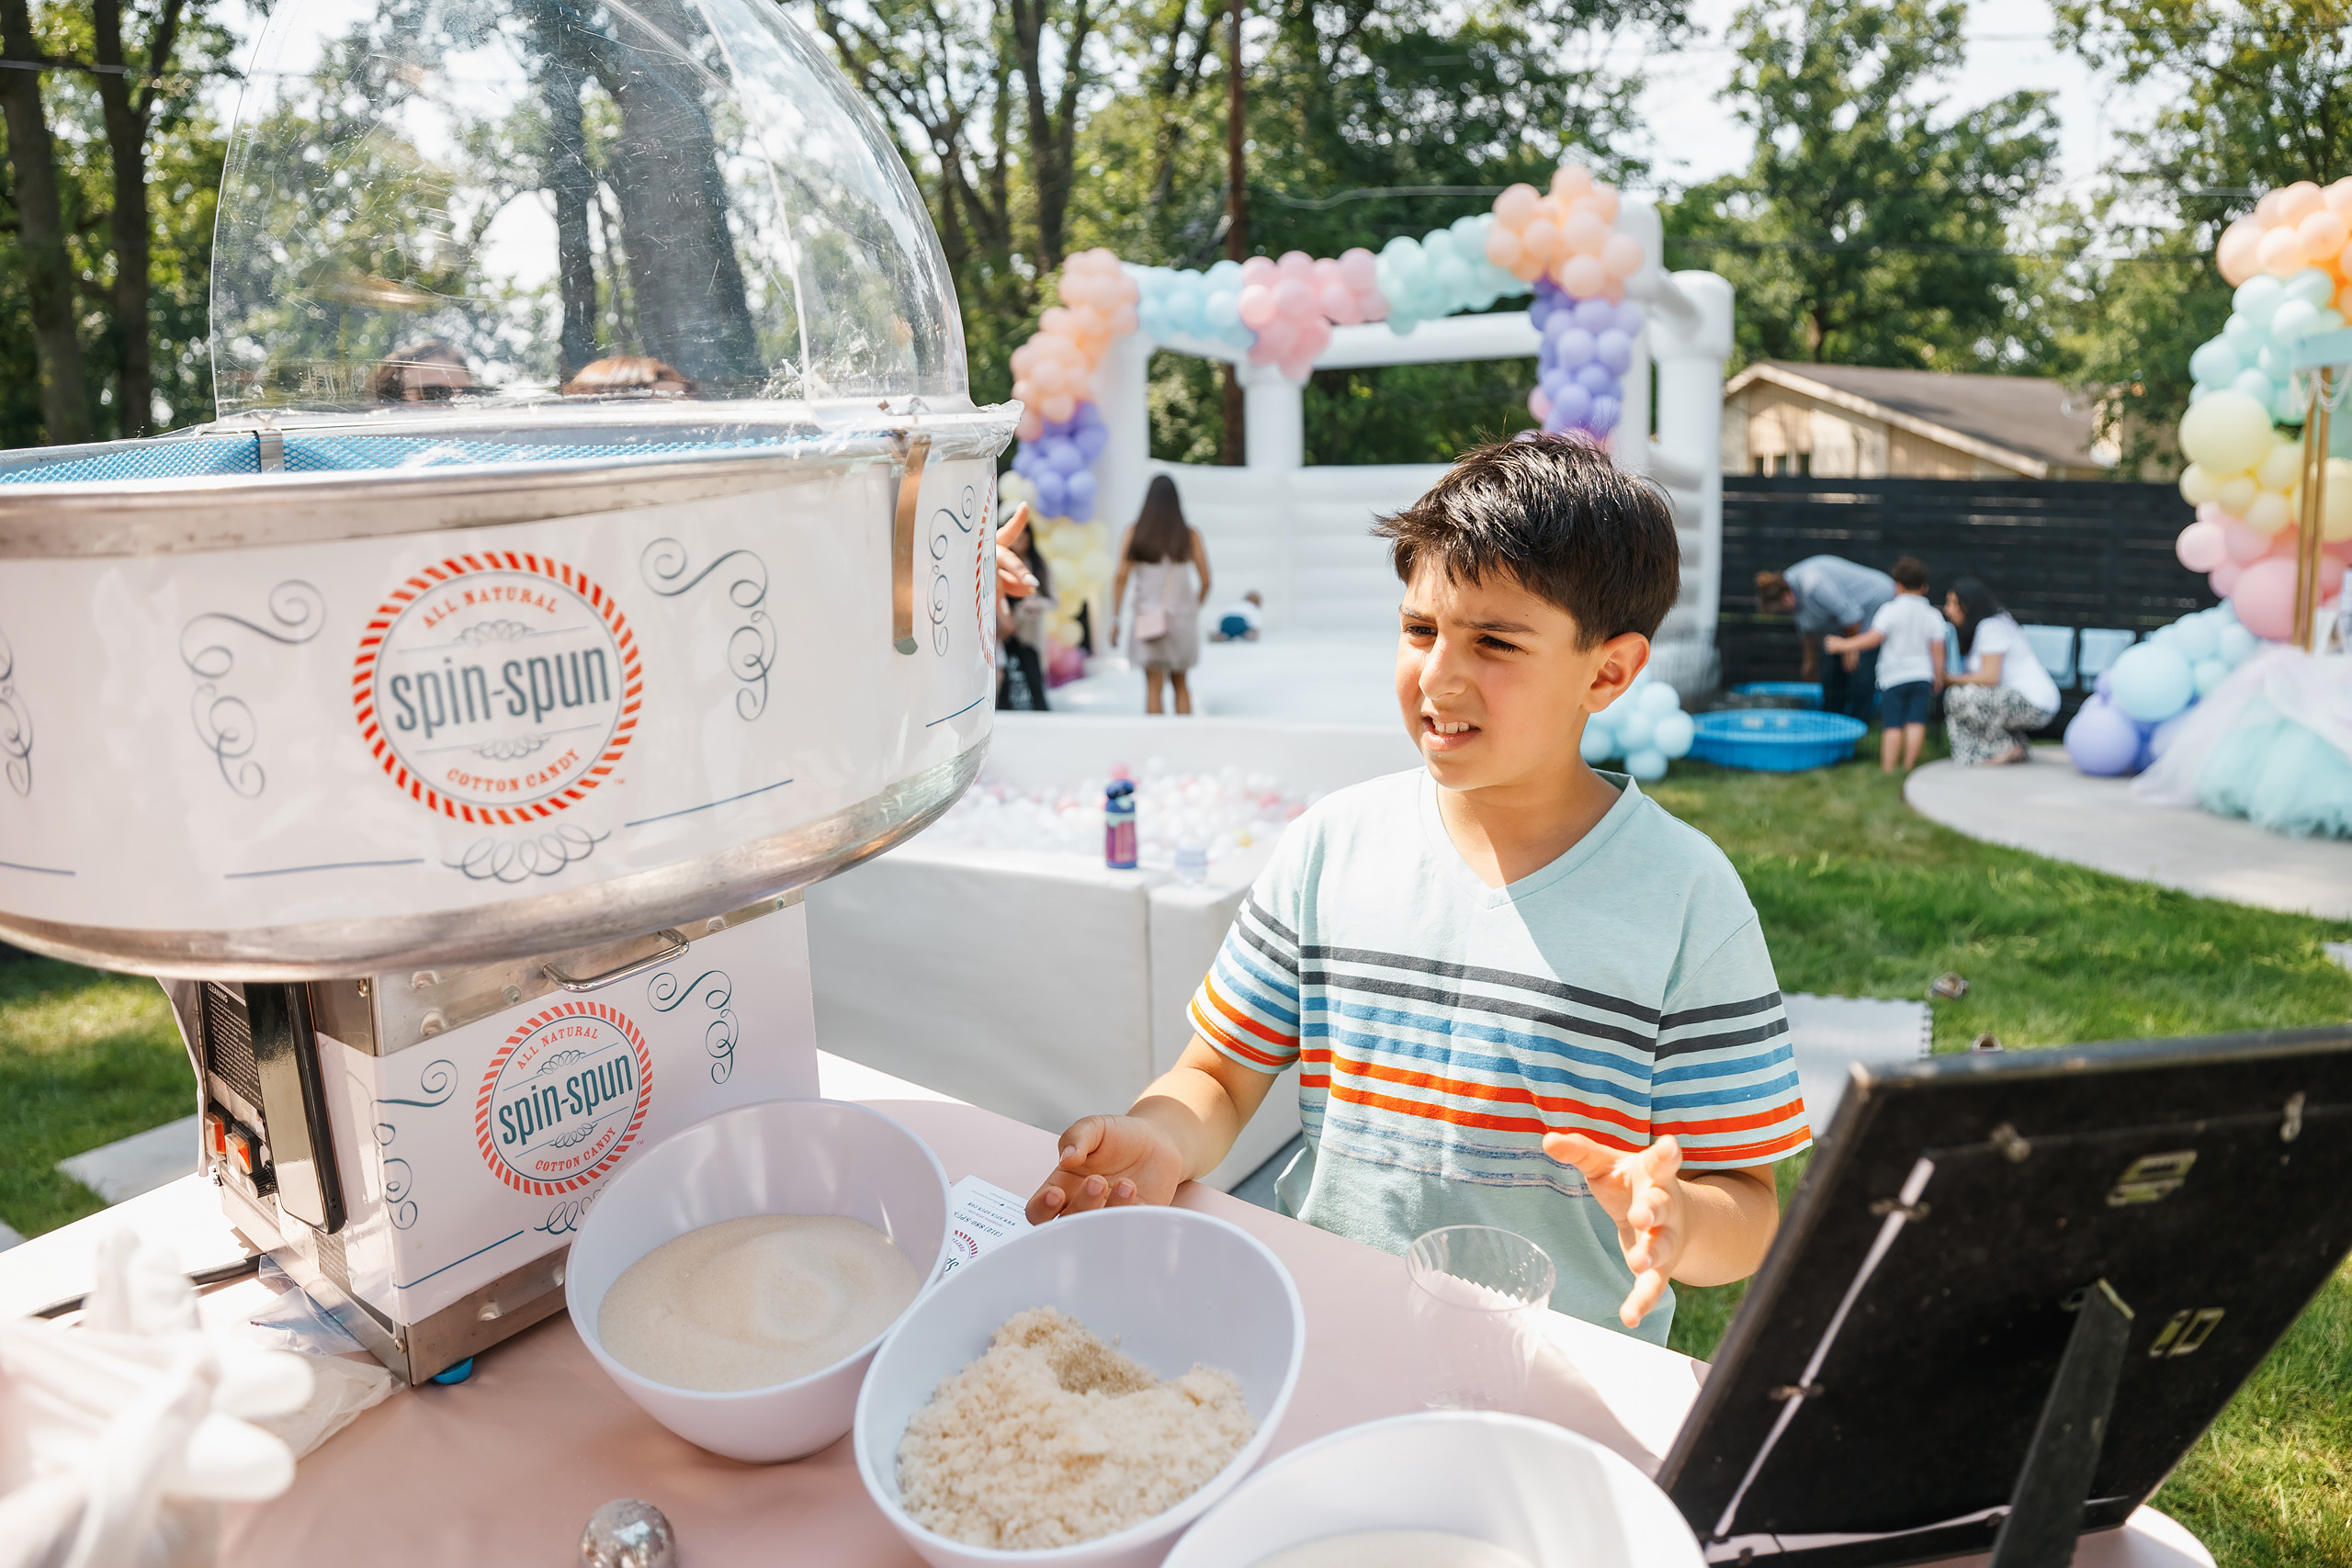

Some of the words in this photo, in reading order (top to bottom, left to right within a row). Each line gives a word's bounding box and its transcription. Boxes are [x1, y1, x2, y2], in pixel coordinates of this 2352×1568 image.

[423, 599, 459, 629] ALL
[463, 586, 558, 614] NATURAL
[390, 647, 611, 739] spin-spun
[446, 768, 519, 792] COTTON
[526, 749, 580, 787] CANDY
[208, 983, 228, 1003] CLEANING
[517, 1046, 539, 1070] ALL
[541, 1026, 599, 1046] NATURAL
[499, 1055, 634, 1145] spin-spun
[535, 1156, 580, 1172] COTTON
[583, 1127, 616, 1160] CANDY
